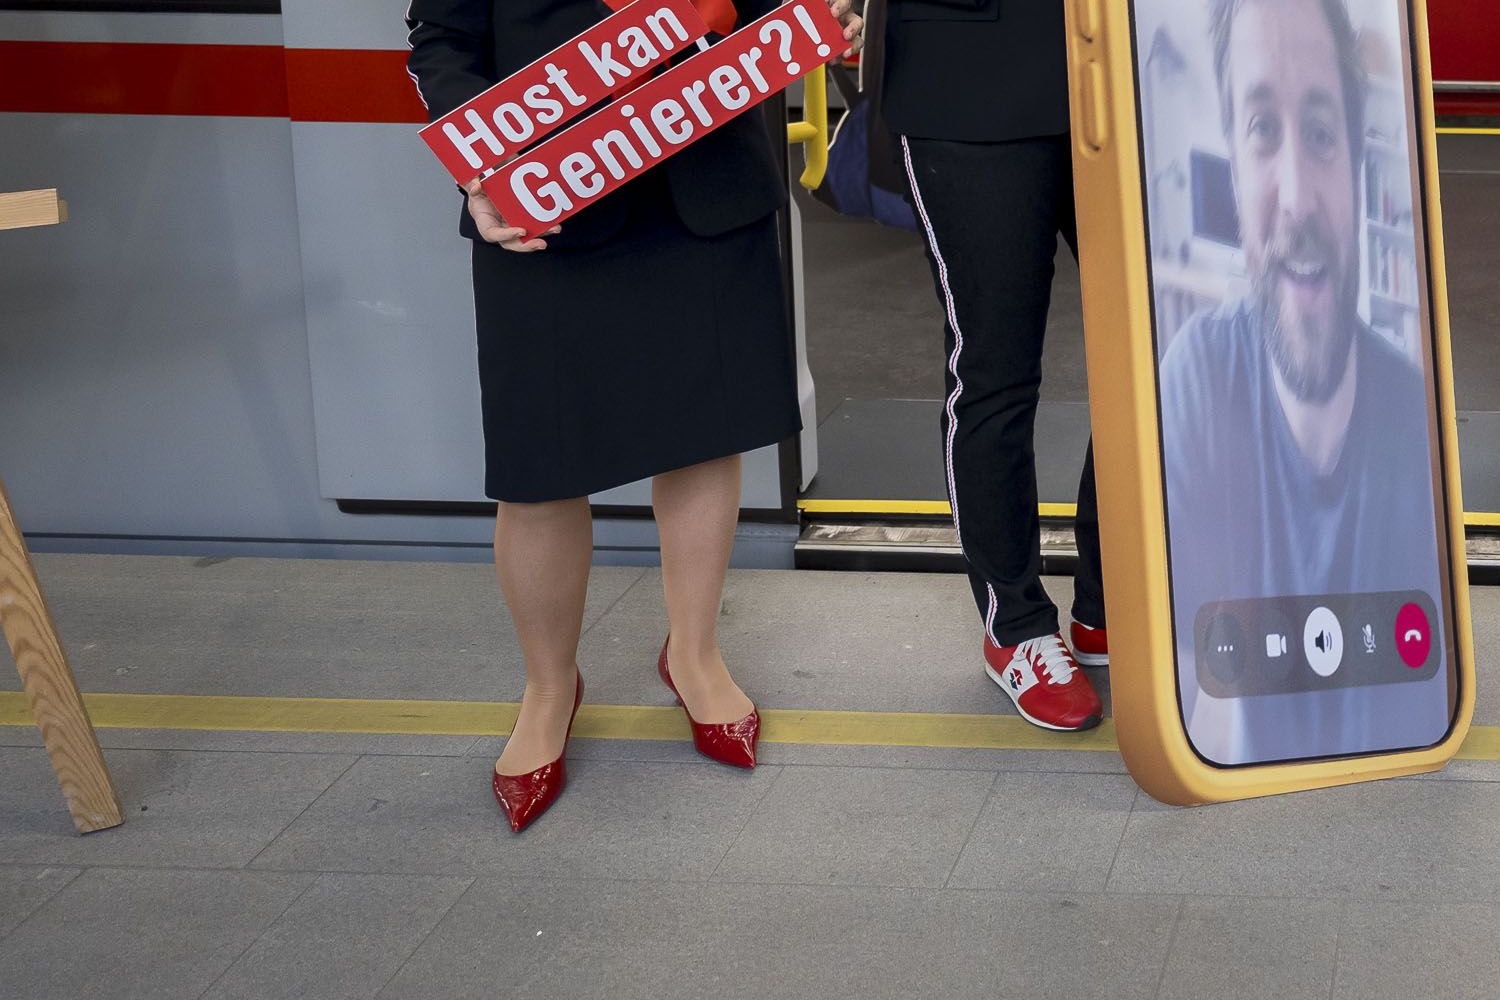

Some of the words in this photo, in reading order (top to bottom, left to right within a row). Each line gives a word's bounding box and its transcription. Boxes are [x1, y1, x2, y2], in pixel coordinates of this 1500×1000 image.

[441, 62, 588, 170] Host
[577, 7, 690, 88] kan
[509, 4, 831, 223] Genierer?!
